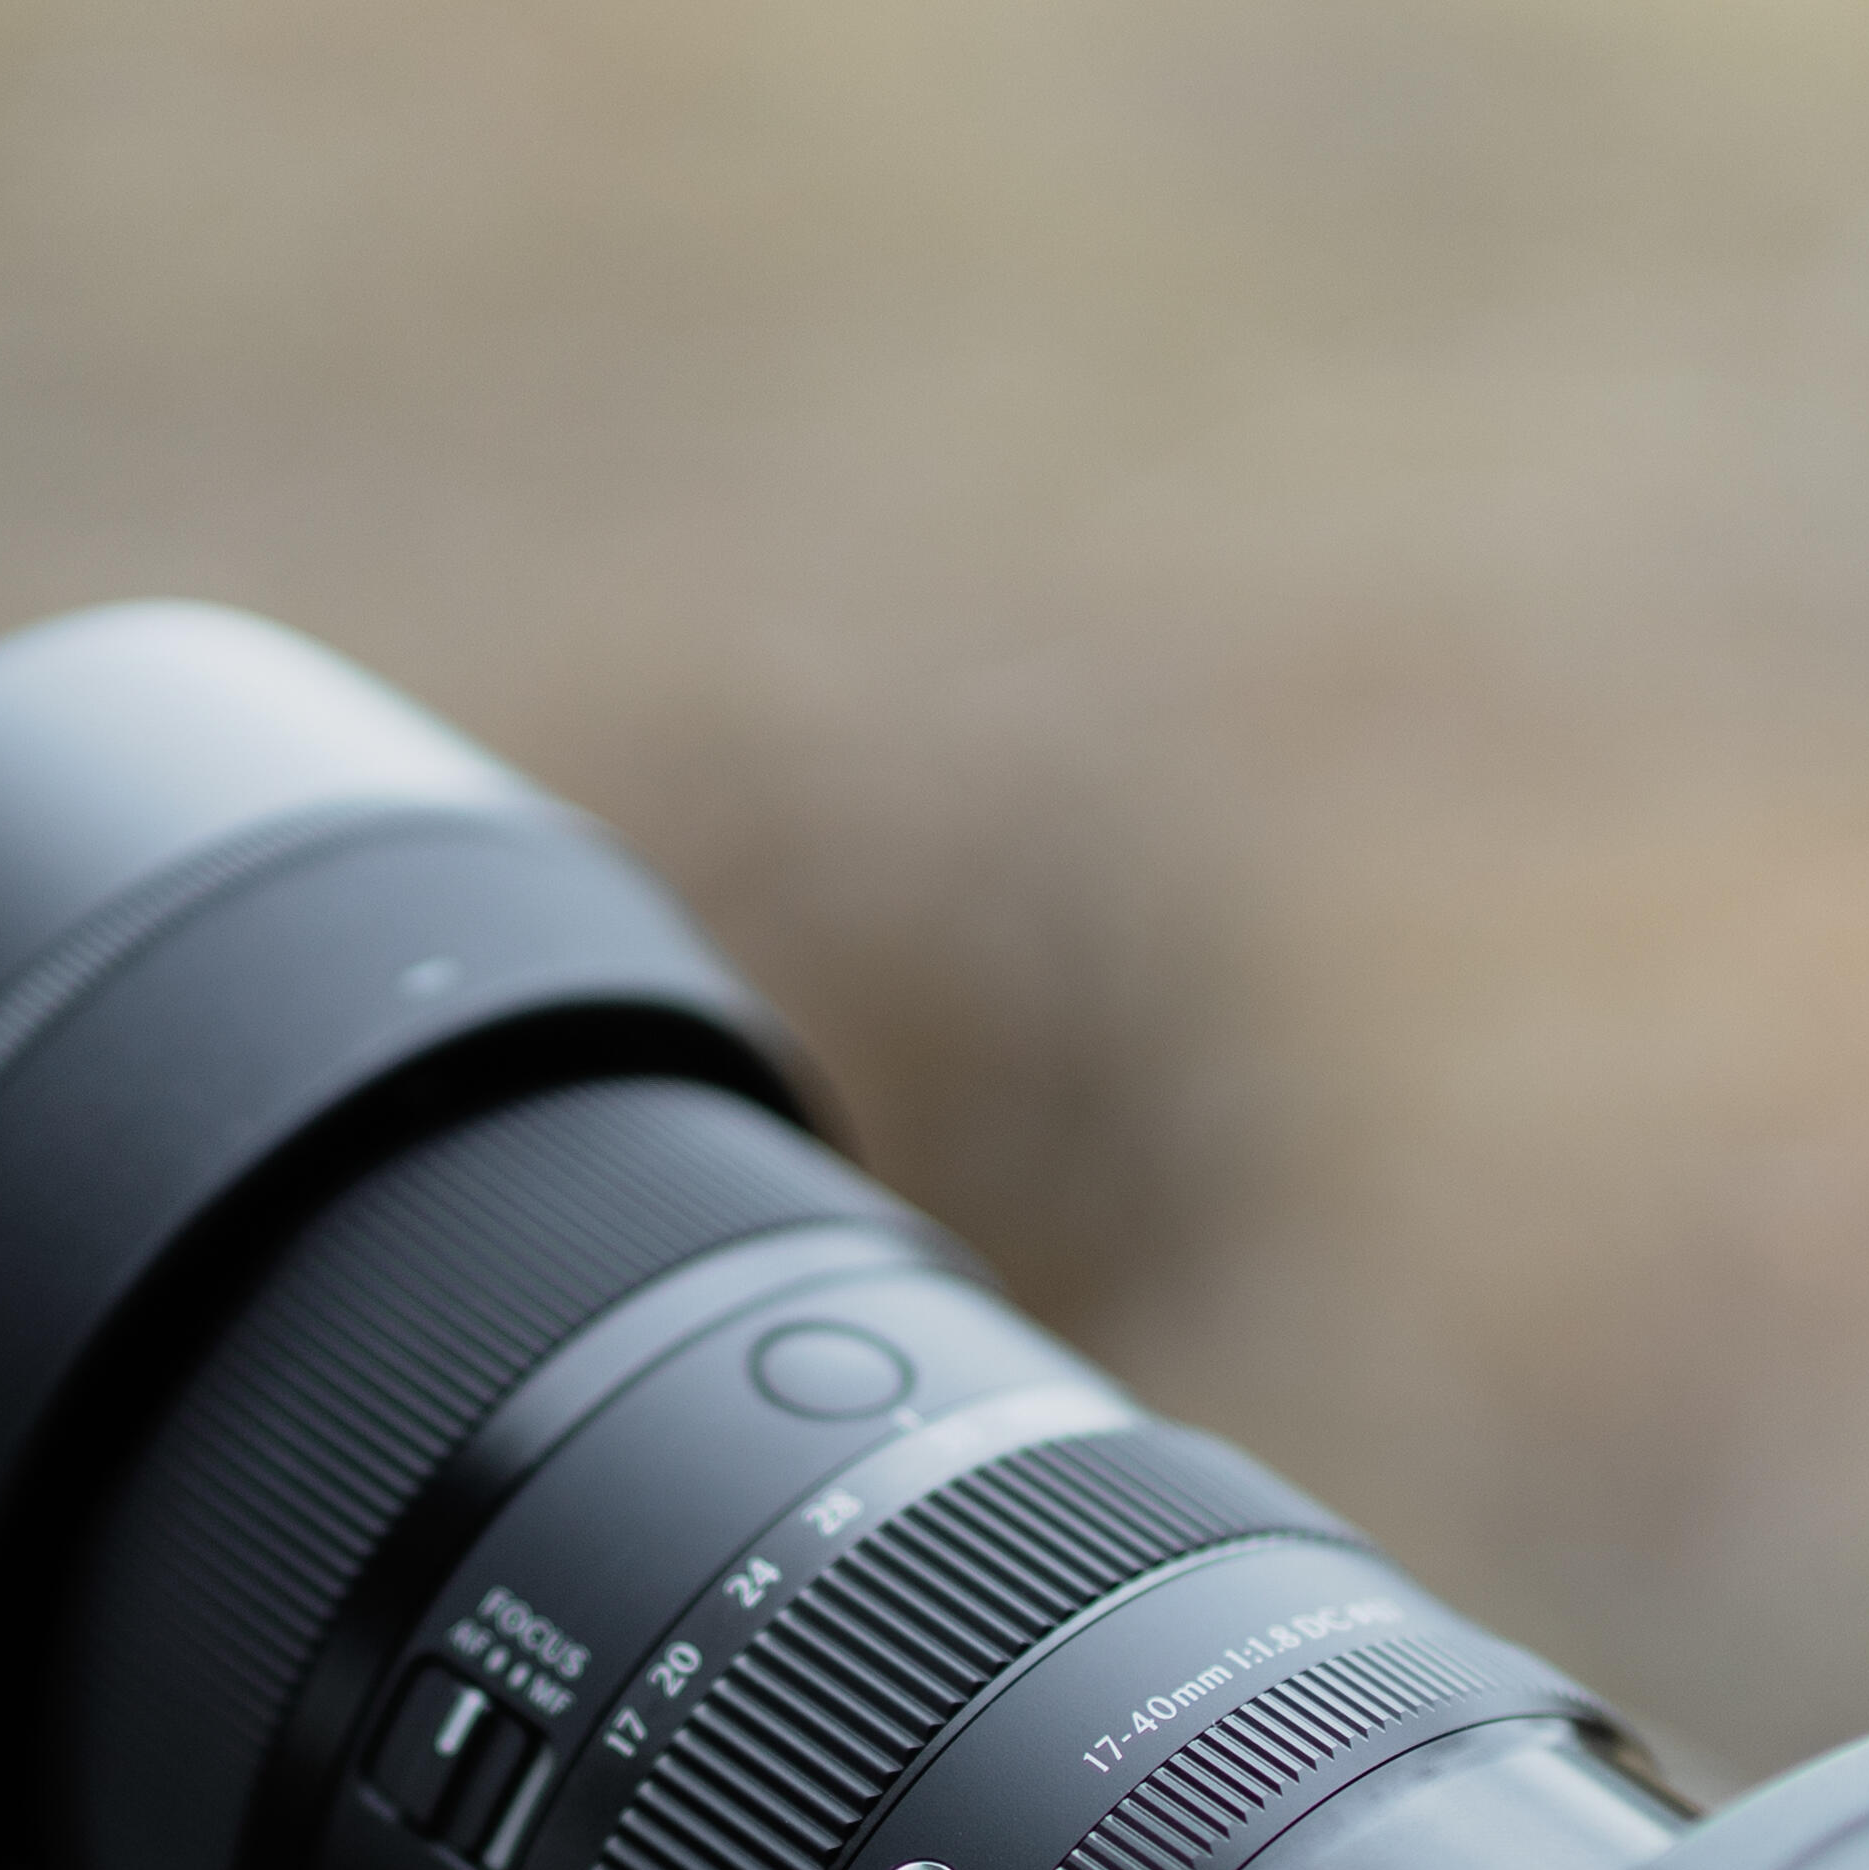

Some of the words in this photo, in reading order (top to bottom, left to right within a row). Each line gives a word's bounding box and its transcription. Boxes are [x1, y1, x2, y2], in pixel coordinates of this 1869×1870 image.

[724, 1556, 782, 1609] 24
[478, 1586, 590, 1679] FOCUS
[647, 1641, 702, 1699] 20
[1082, 1662, 1234, 1774] 17-40mm
[1223, 1624, 1301, 1670] 1:1.8
[1293, 1605, 1354, 1641] DC
[604, 1707, 648, 1759] 17
